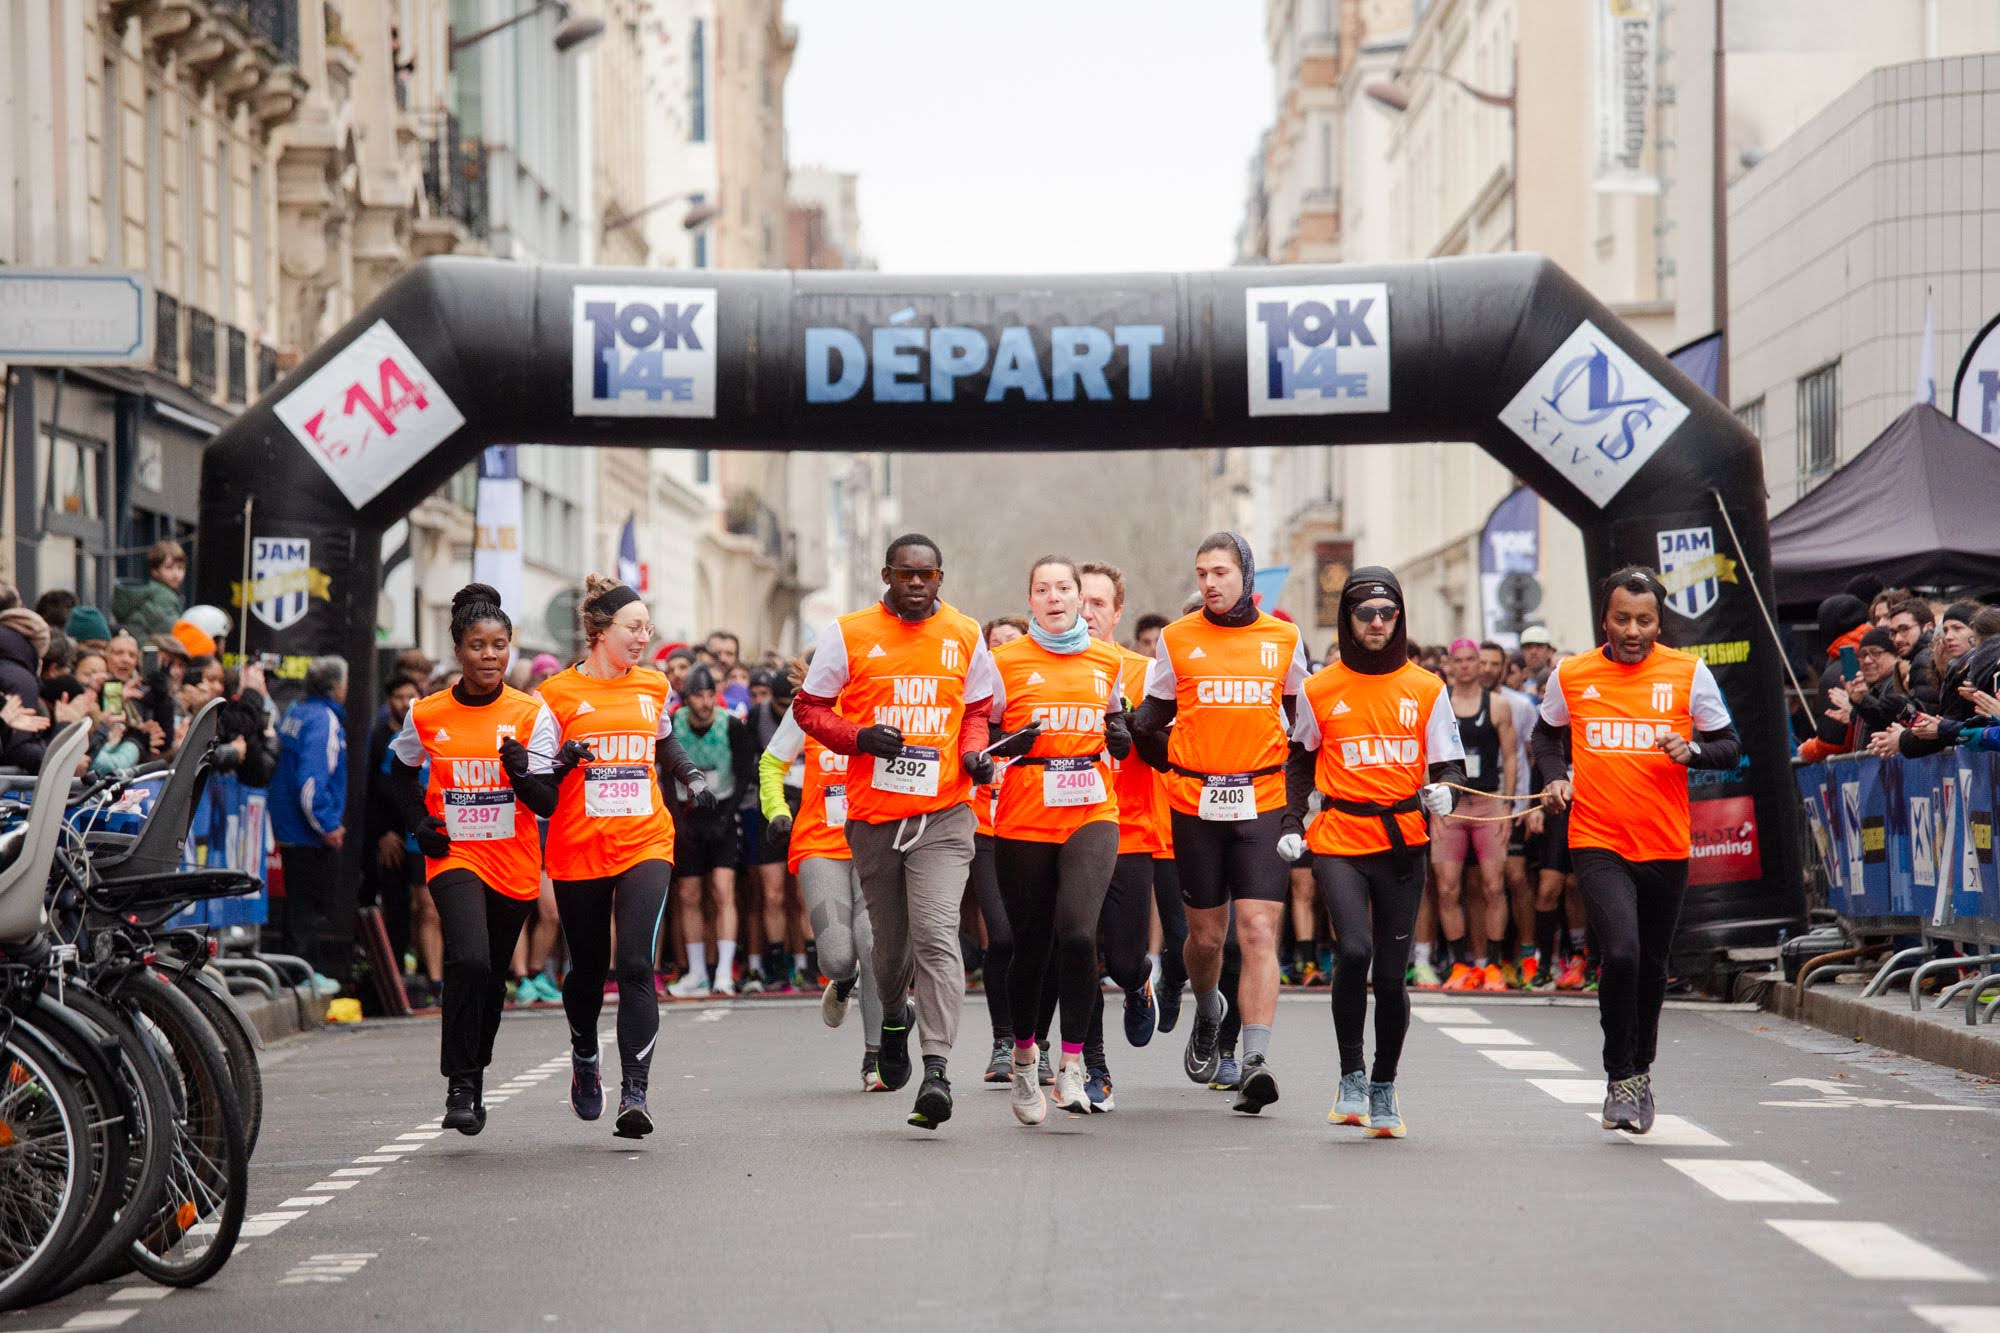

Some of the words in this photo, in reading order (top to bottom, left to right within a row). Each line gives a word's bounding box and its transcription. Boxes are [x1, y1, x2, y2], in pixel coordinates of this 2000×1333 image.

[806, 307, 1164, 402] DÉPART
[257, 543, 305, 560] JAM
[1661, 531, 1710, 553] JAM
[893, 677, 938, 705] NON
[1197, 680, 1275, 704] GUIDE
[874, 705, 952, 733] VOYANT
[1031, 706, 1107, 732] GUIDE
[582, 735, 656, 761] GUIDE
[1341, 738, 1419, 768] BLIND
[452, 760, 500, 786] NON
[590, 767, 617, 775] 10KM
[885, 759, 927, 777] 2392
[1688, 767, 1744, 788] LECTRIC
[598, 782, 640, 798] 2399
[1056, 772, 1096, 788] 2400
[451, 793, 476, 801] 10KM
[1210, 788, 1244, 803] 2403
[457, 807, 500, 823] 2397
